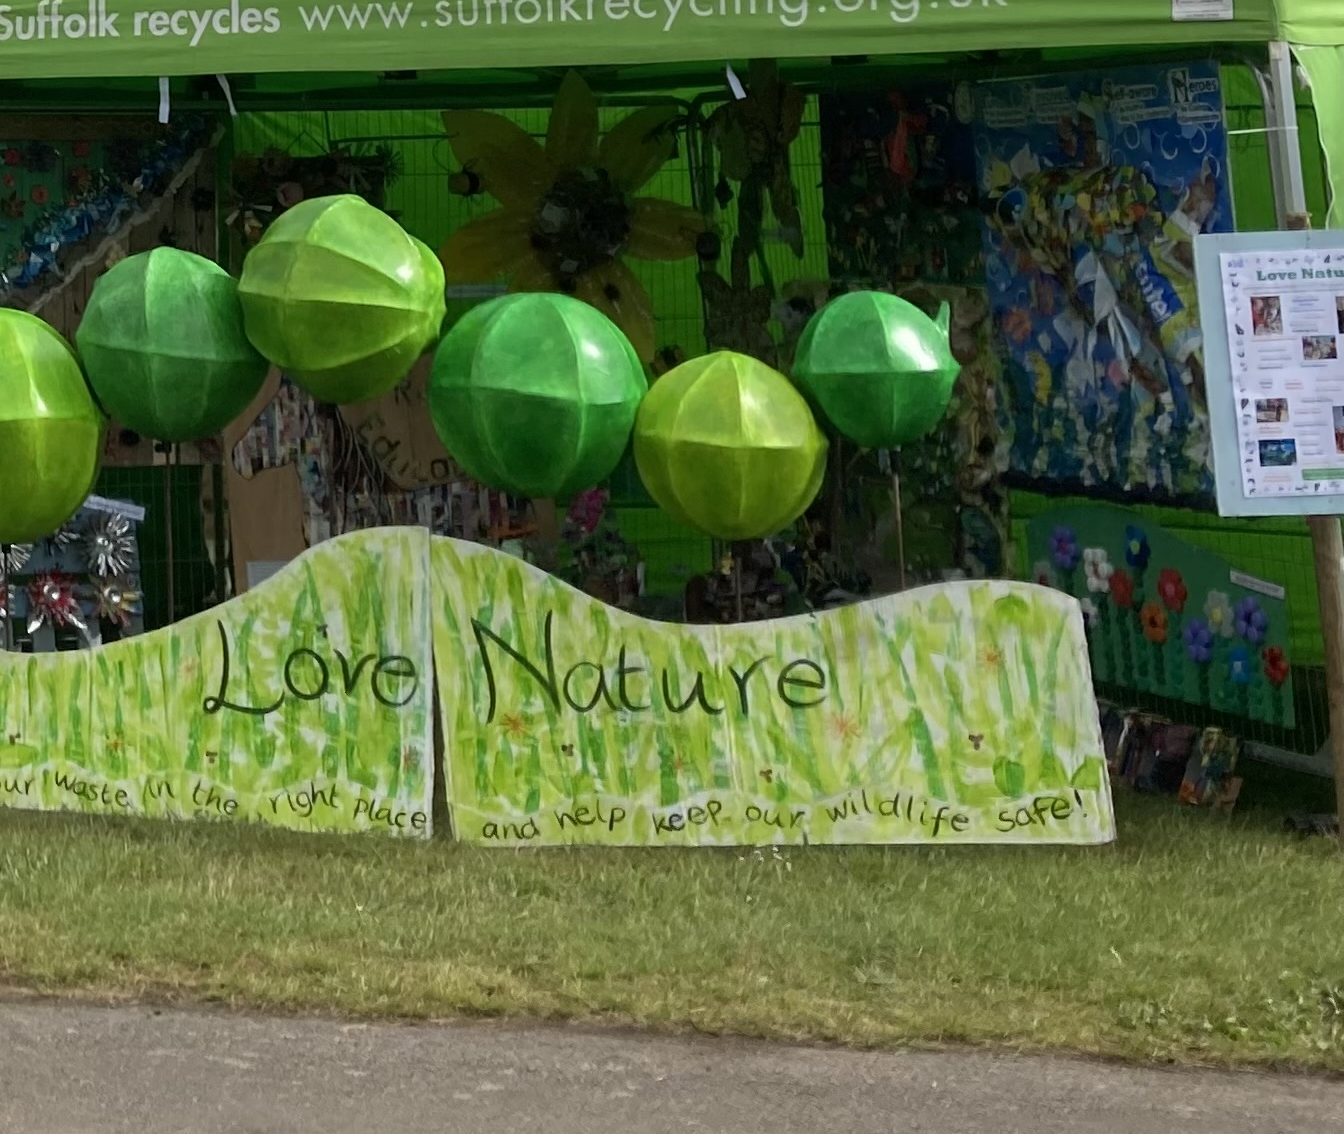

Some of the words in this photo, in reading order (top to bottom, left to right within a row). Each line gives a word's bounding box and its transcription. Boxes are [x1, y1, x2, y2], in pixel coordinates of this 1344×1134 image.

[1256, 270, 1298, 282] Love
[1301, 268, 1344, 280] Natu
[202, 618, 418, 715] Love
[470, 609, 827, 725] Nature
[55, 769, 129, 808] waste
[144, 777, 175, 801] in
[192, 779, 239, 816] the
[269, 778, 339, 818] right
[481, 810, 541, 841] and
[553, 795, 628, 832] help
[744, 805, 806, 830] our
[825, 788, 971, 837] wildlife
[996, 788, 1090, 834] safe!
